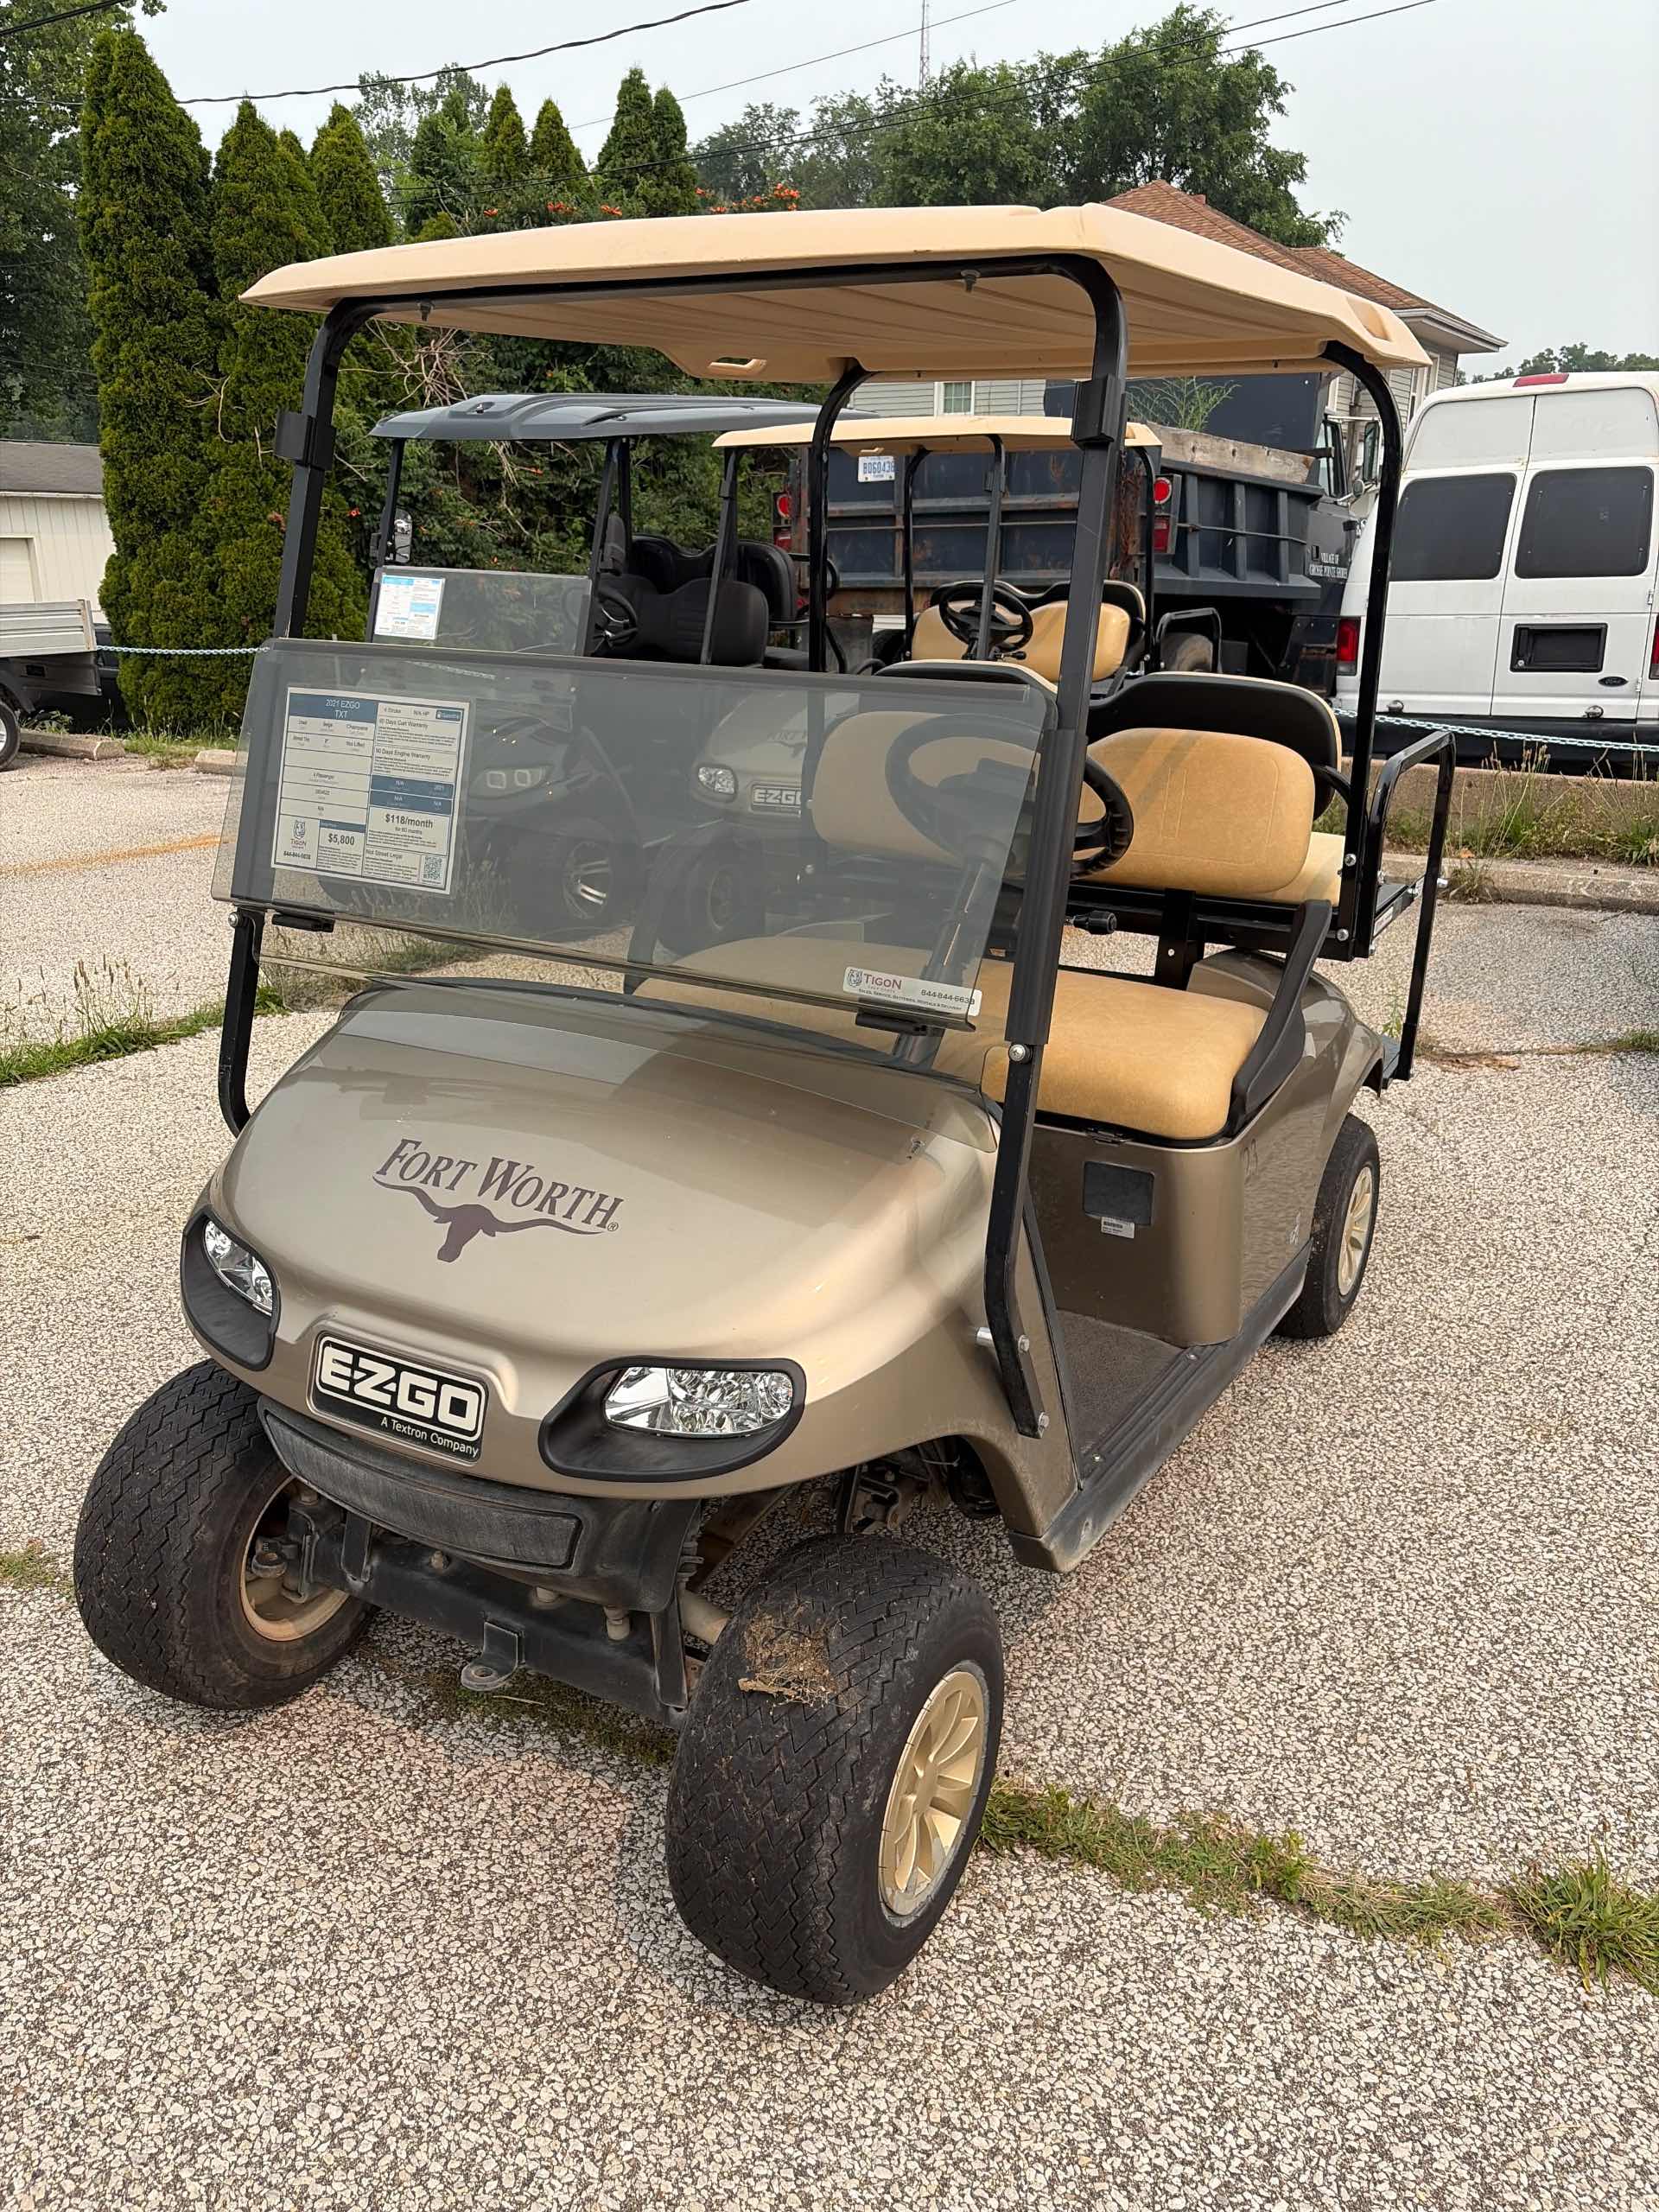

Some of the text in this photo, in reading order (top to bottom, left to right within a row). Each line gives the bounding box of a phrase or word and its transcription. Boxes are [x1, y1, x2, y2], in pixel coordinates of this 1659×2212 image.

[340, 700, 360, 709] EZGO
[334, 709, 348, 719] TXT
[385, 813, 434, 829] $118/month
[327, 832, 355, 846] $5,800
[863, 973, 902, 990] TIGON
[375, 1138, 624, 1230] FORT WORTH
[321, 1345, 480, 1432] EZGO
[380, 1416, 480, 1459] A Textron Company
